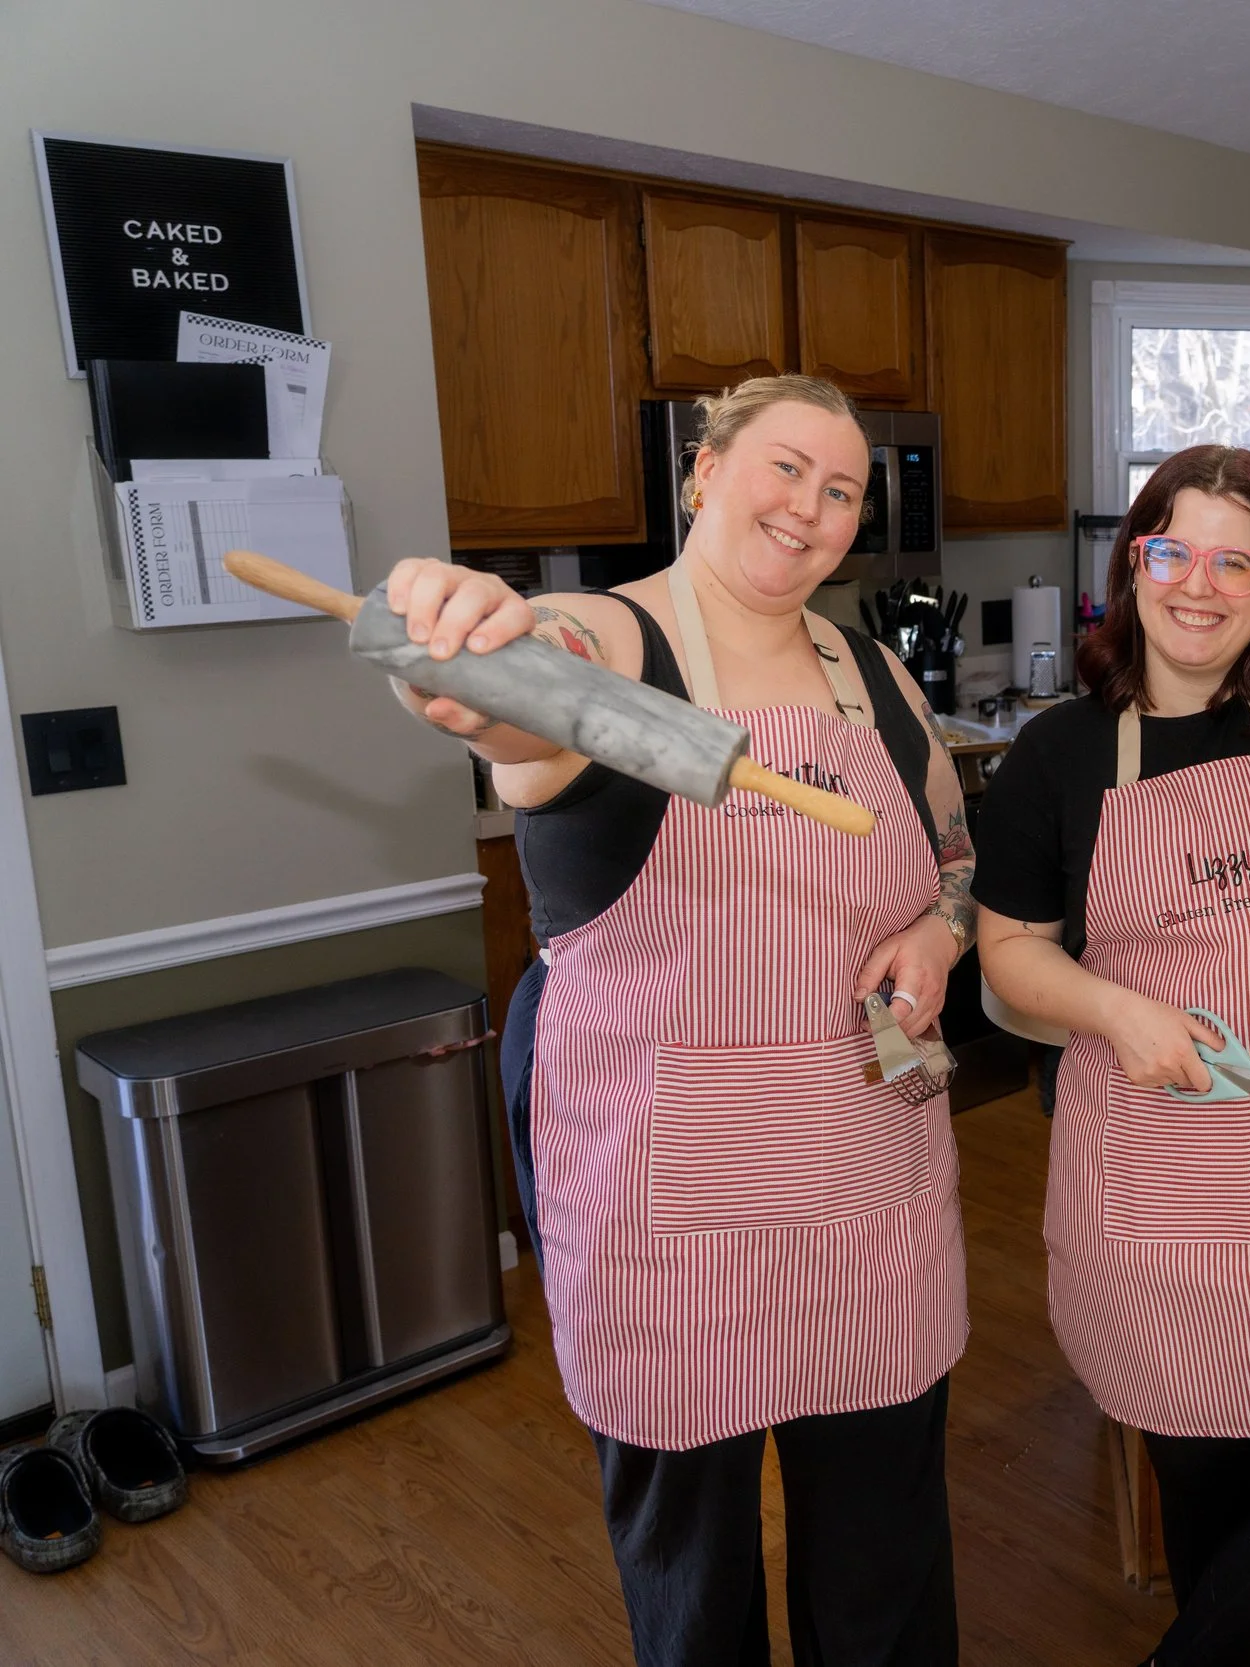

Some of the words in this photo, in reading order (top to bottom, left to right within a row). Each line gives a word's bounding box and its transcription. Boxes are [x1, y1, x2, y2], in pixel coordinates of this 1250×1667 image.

[123, 219, 223, 245] CAKED
[172, 247, 189, 266] &
[132, 269, 229, 292] BAKED
[199, 333, 258, 355] ORDER
[262, 345, 310, 364] FORM
[149, 502, 167, 549] FORM
[154, 552, 174, 607] ORDER
[724, 803, 786, 819] Cookie
[1156, 905, 1216, 929] Gluten
